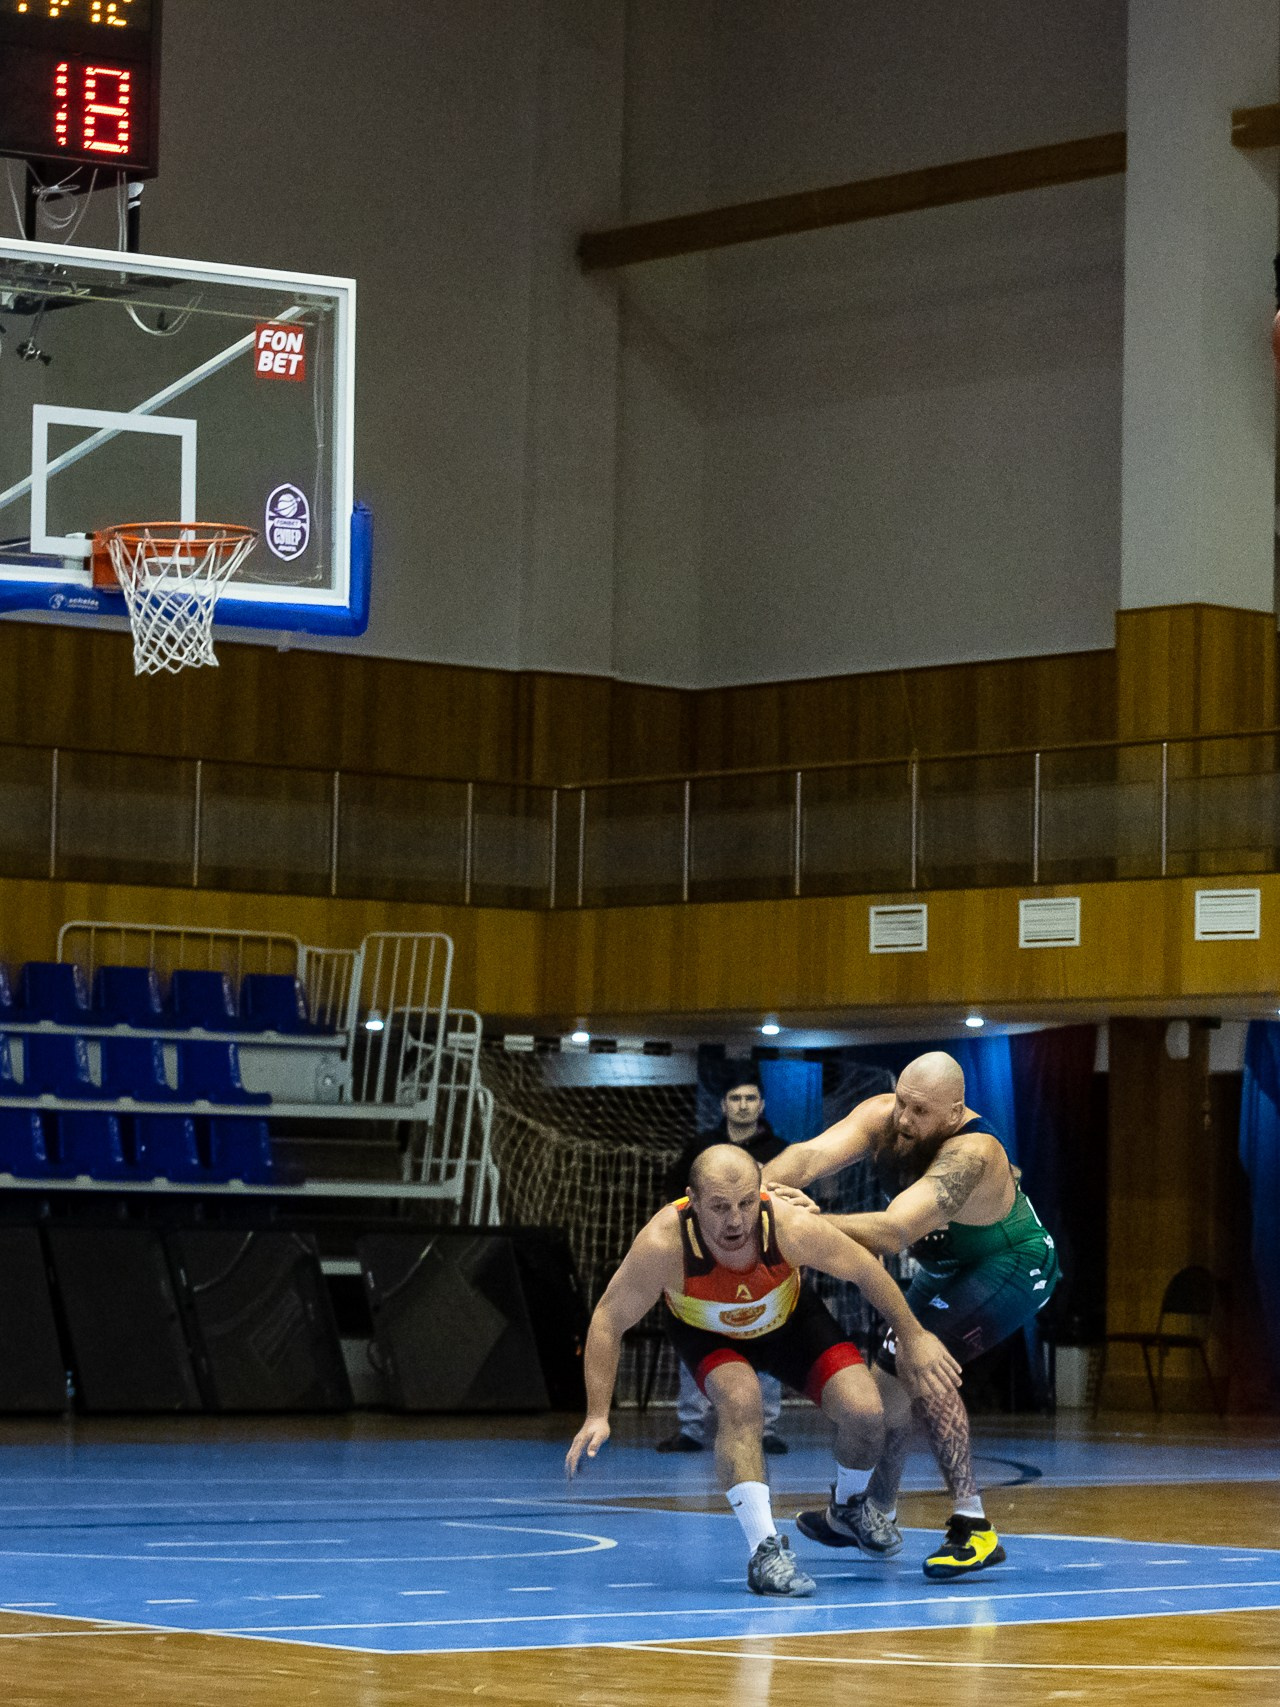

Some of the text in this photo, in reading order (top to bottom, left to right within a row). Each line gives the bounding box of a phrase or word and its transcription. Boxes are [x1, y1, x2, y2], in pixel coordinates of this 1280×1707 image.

[55, 62, 131, 154] 18
[258, 329, 304, 353] FON
[257, 351, 303, 375] BET
